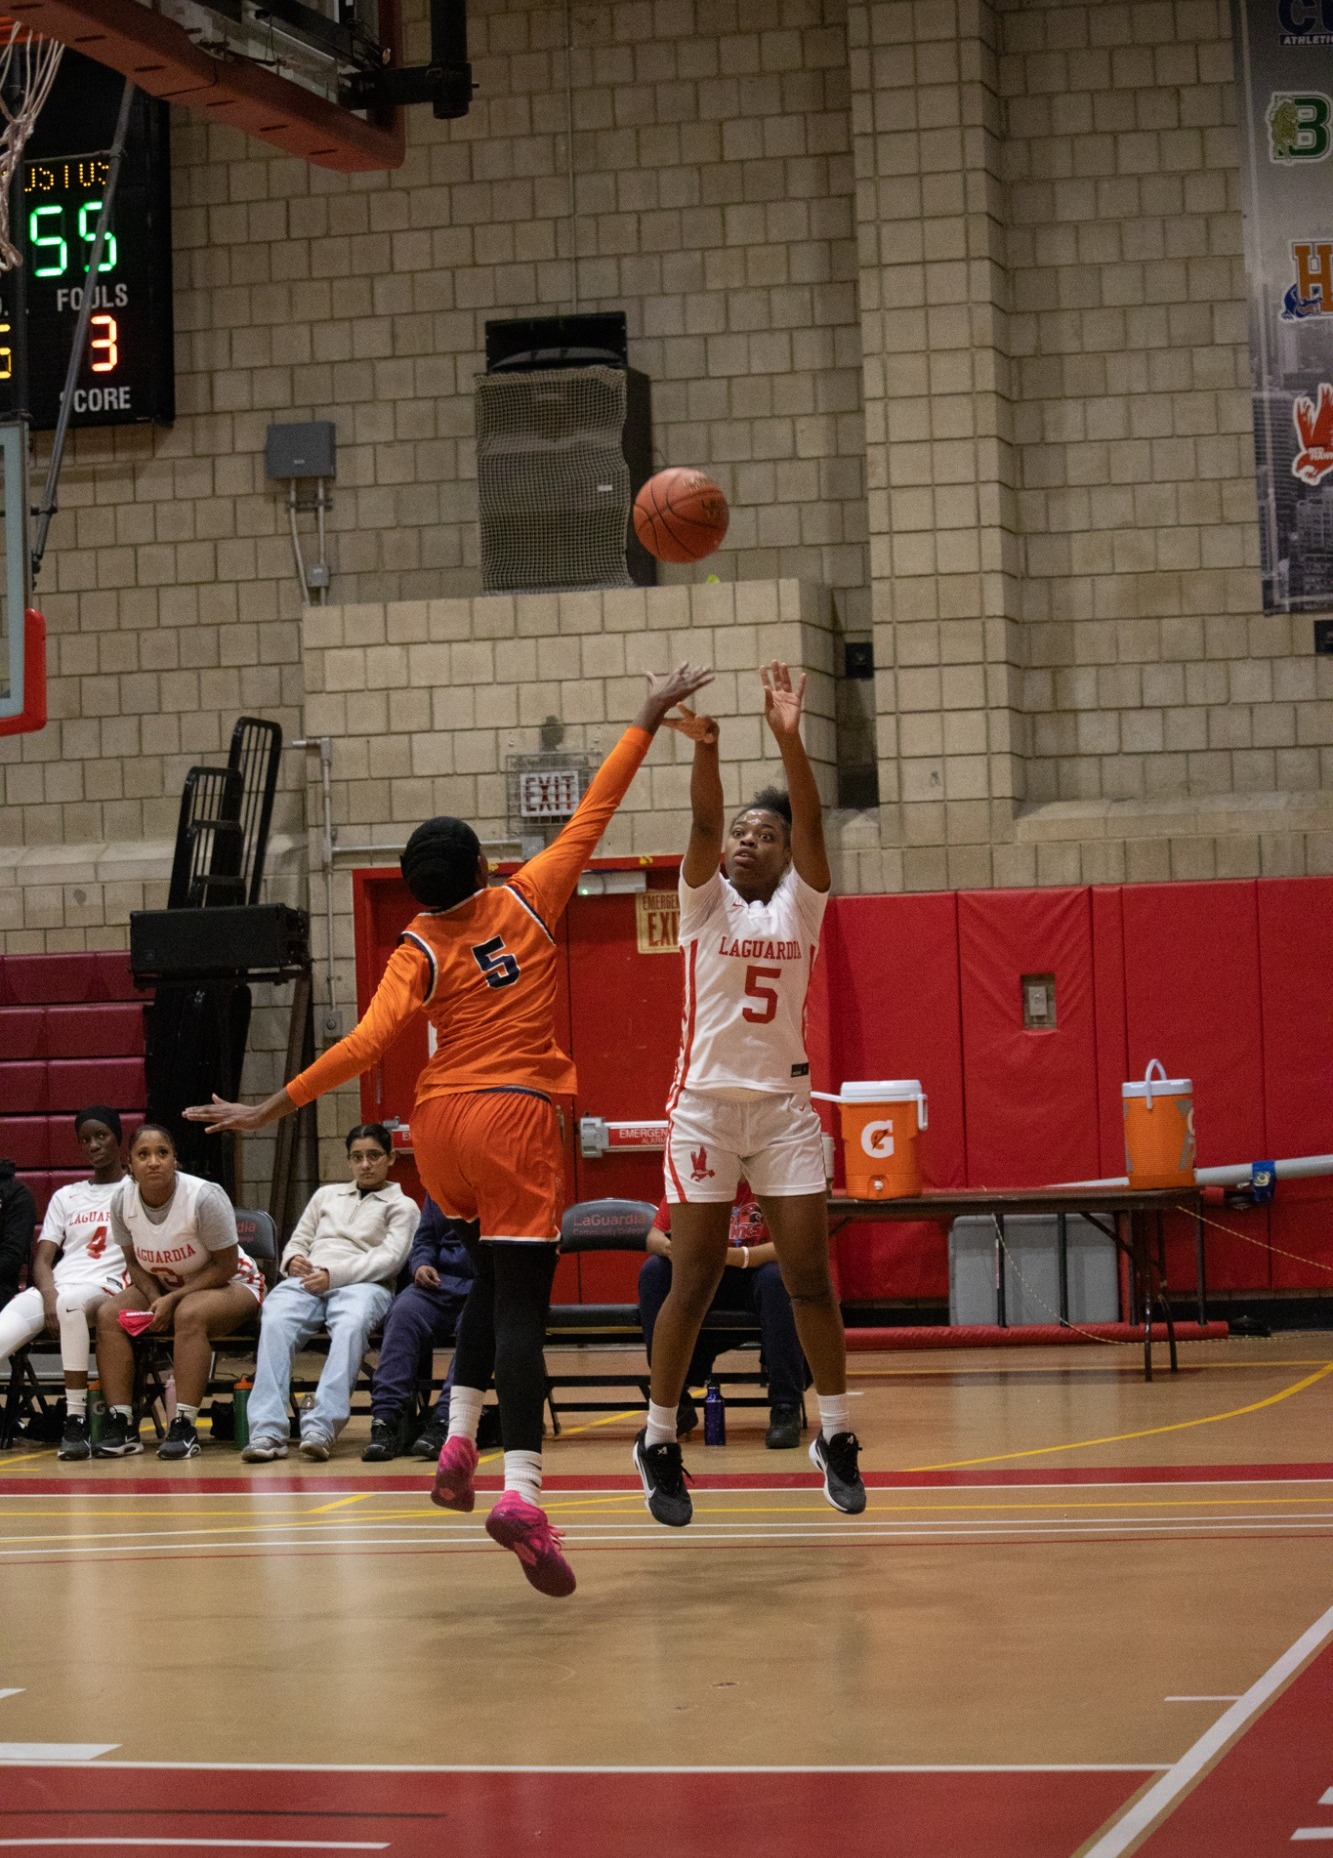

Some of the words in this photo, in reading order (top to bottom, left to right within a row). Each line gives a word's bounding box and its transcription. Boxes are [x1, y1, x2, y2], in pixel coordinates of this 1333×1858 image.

[30, 200, 118, 277] 55
[56, 282, 129, 312] FOULS
[90, 314, 118, 372] 3
[59, 386, 132, 413] CORE
[525, 775, 575, 812] EXIT
[647, 911, 680, 946] EXI
[471, 934, 521, 990] 5
[742, 965, 782, 1024] 5
[860, 1119, 895, 1159] G
[573, 1213, 646, 1227] LaGuardia
[86, 1226, 108, 1259] 4
